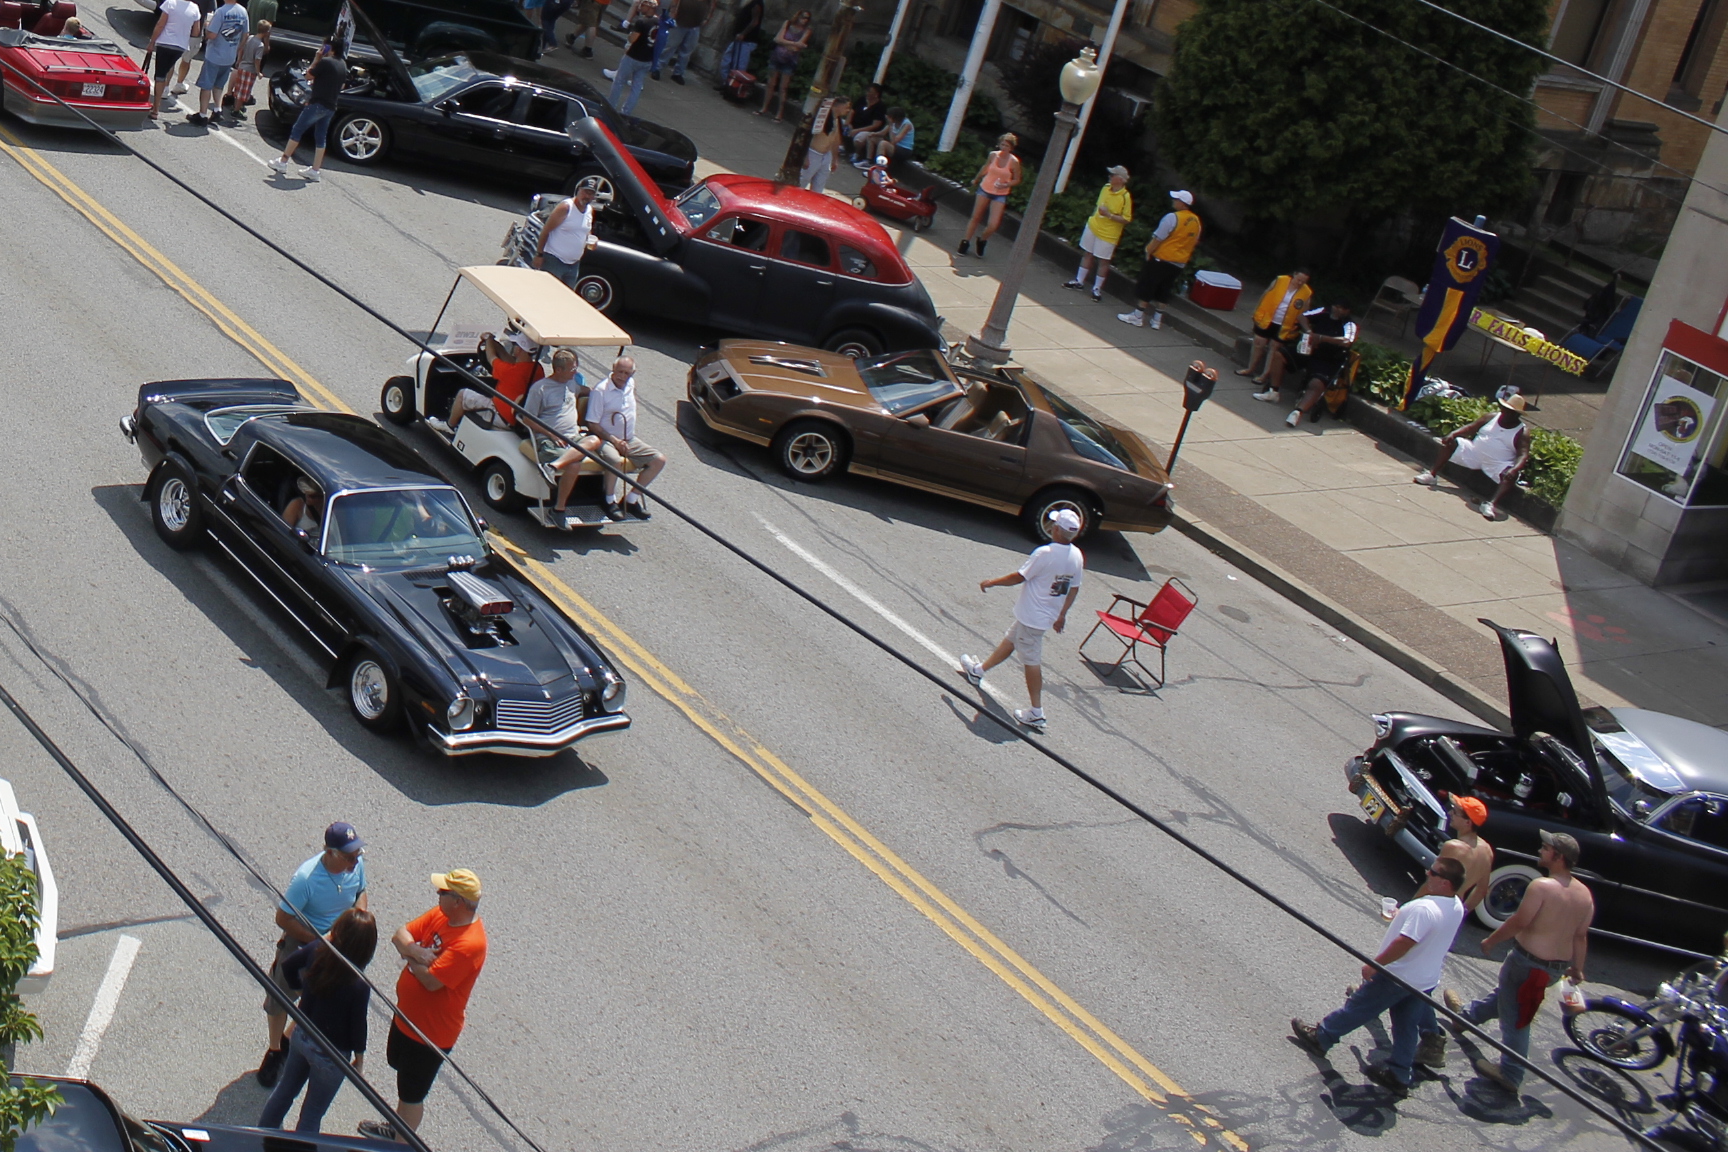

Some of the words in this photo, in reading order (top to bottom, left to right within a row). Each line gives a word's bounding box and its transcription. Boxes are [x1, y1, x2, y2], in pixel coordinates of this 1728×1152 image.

[1460, 237, 1484, 252] LIONS
[1458, 249, 1473, 270] L
[1487, 319, 1531, 348] FALLS
[1537, 344, 1584, 373] LIONS
